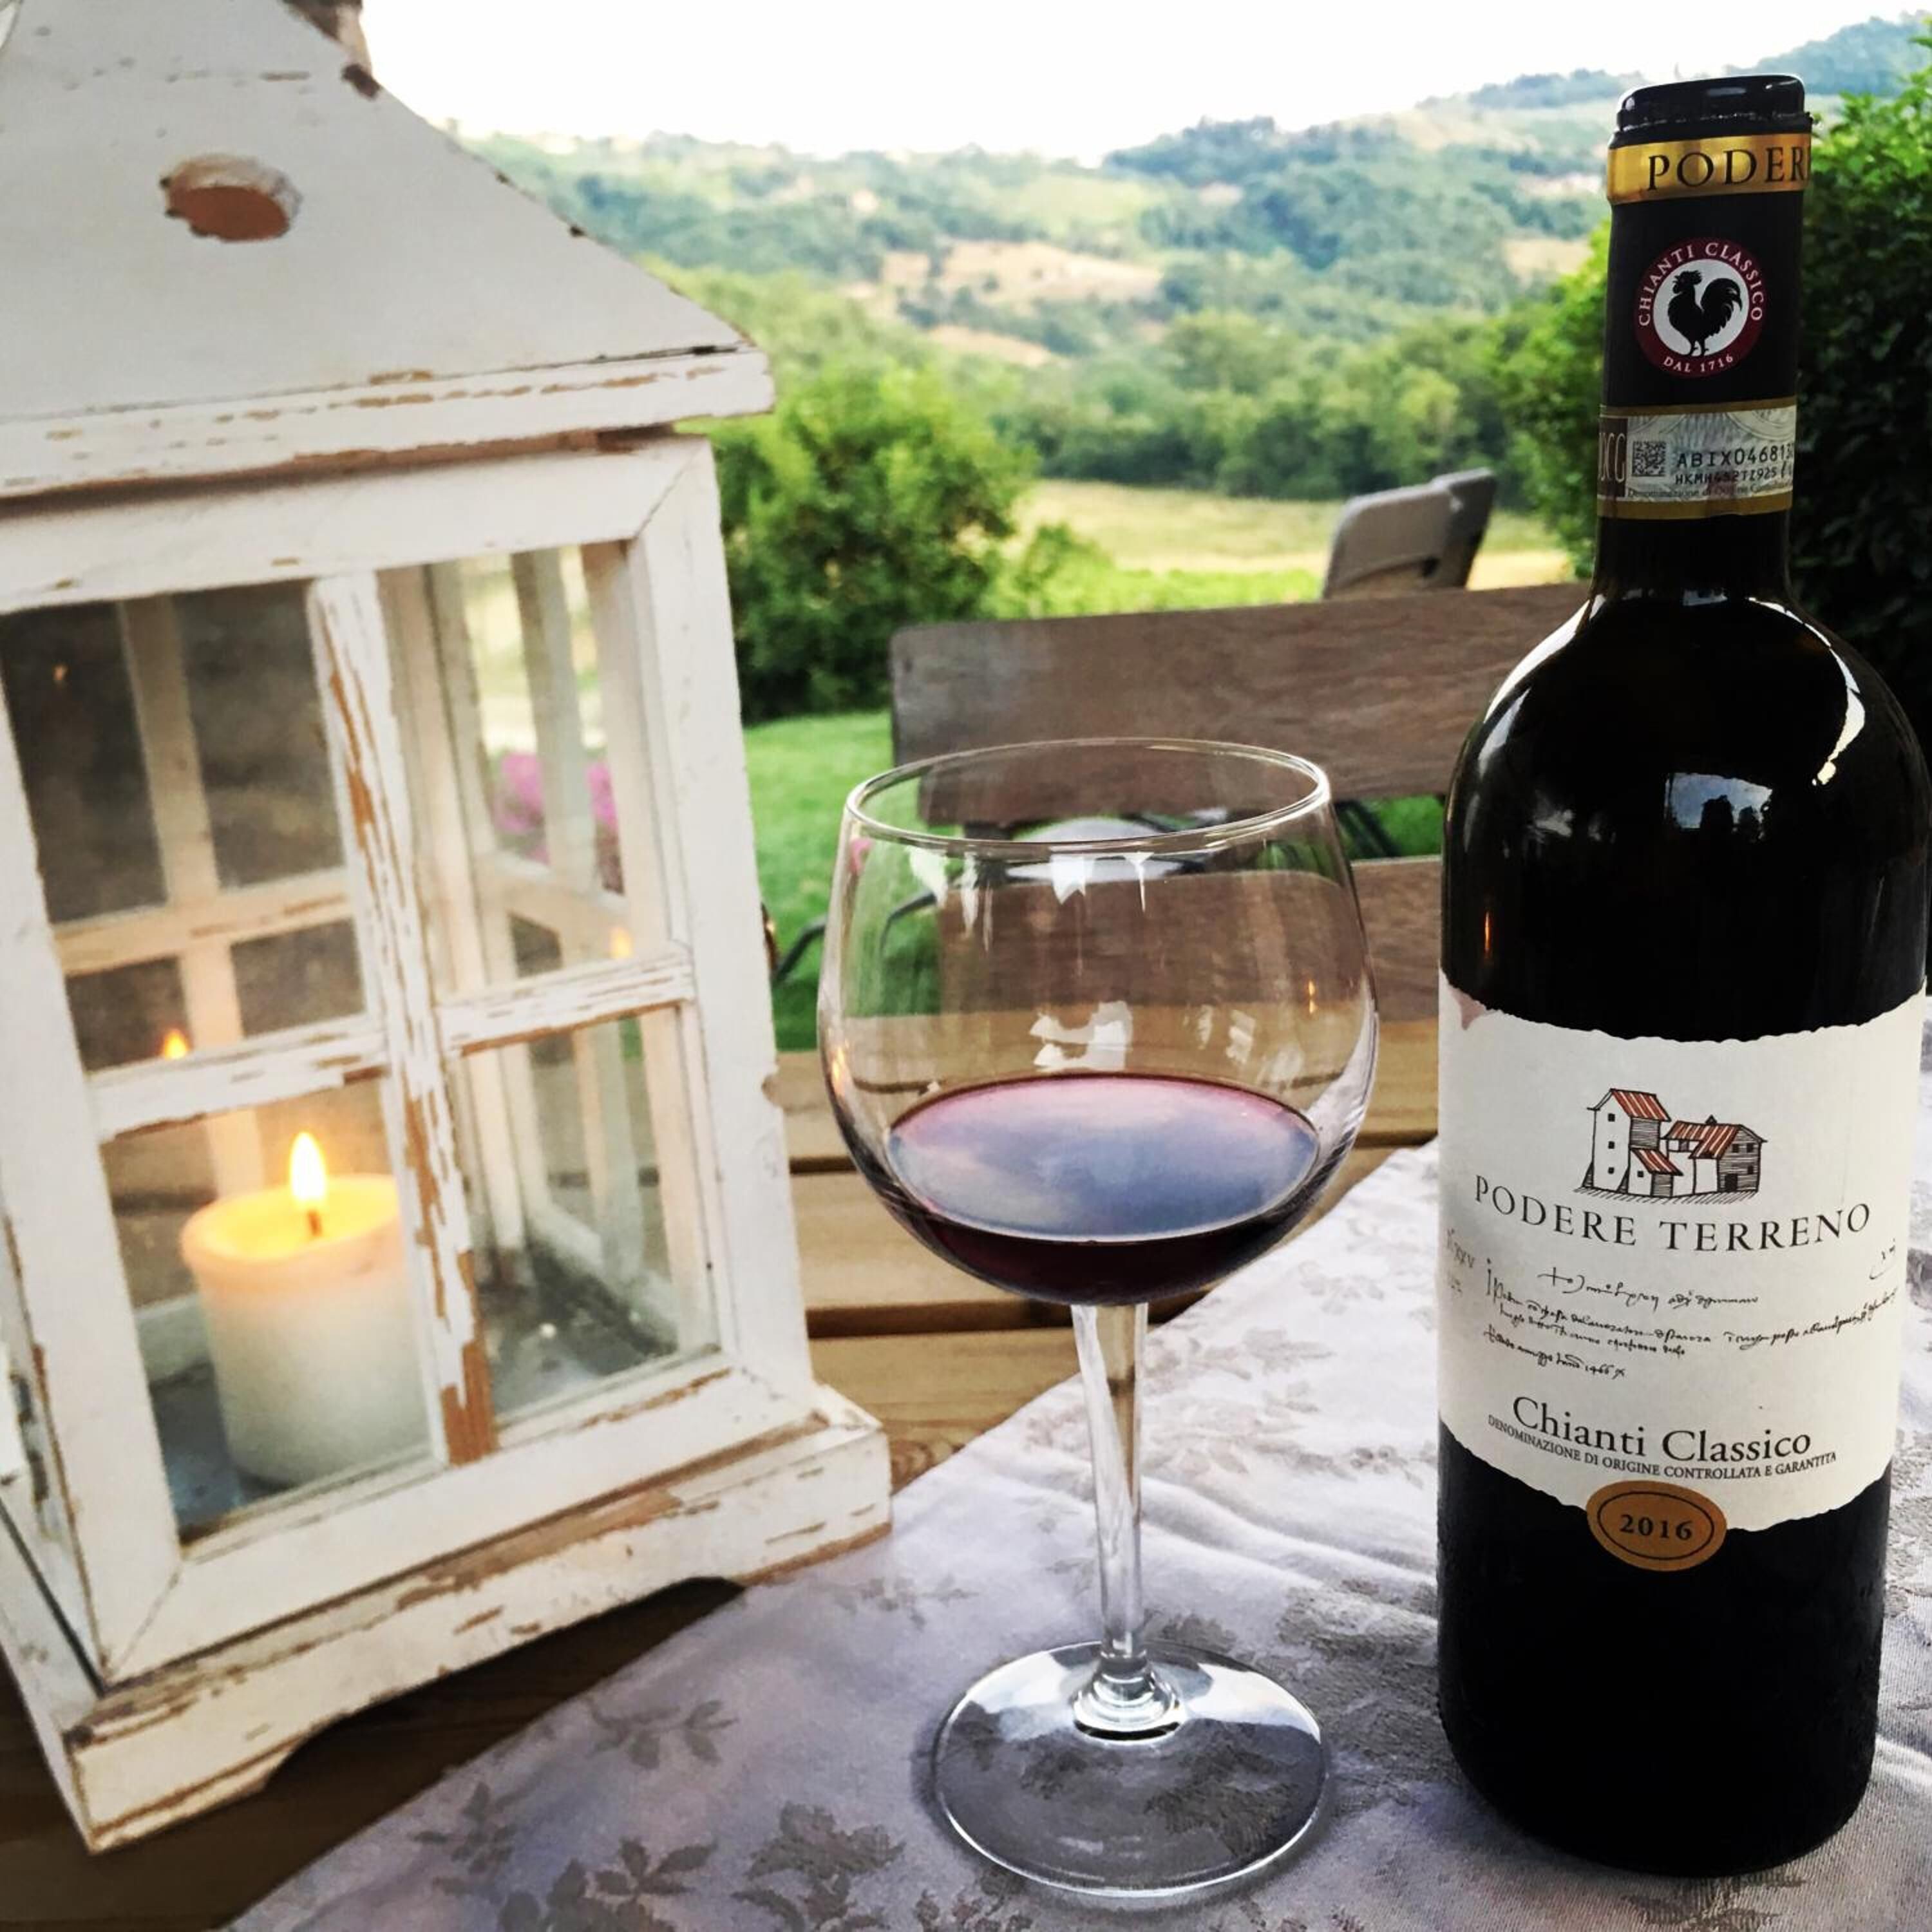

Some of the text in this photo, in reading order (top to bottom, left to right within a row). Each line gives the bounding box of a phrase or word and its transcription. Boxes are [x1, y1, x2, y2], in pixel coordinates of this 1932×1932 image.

[1647, 146, 1811, 191] PODER
[1638, 242, 1764, 327] CHIANTI CLASSICO
[1663, 353, 1733, 373] DAL 1716
[1475, 1175, 1871, 1252] PODERE TERRENO
[1488, 1414, 1836, 1479] DENOMINAZIONE DI ORIGINE CONTROLLATA E GARANTITA
[1513, 1396, 1811, 1462] Chianti Classico
[1620, 1514, 1693, 1541] 2016
